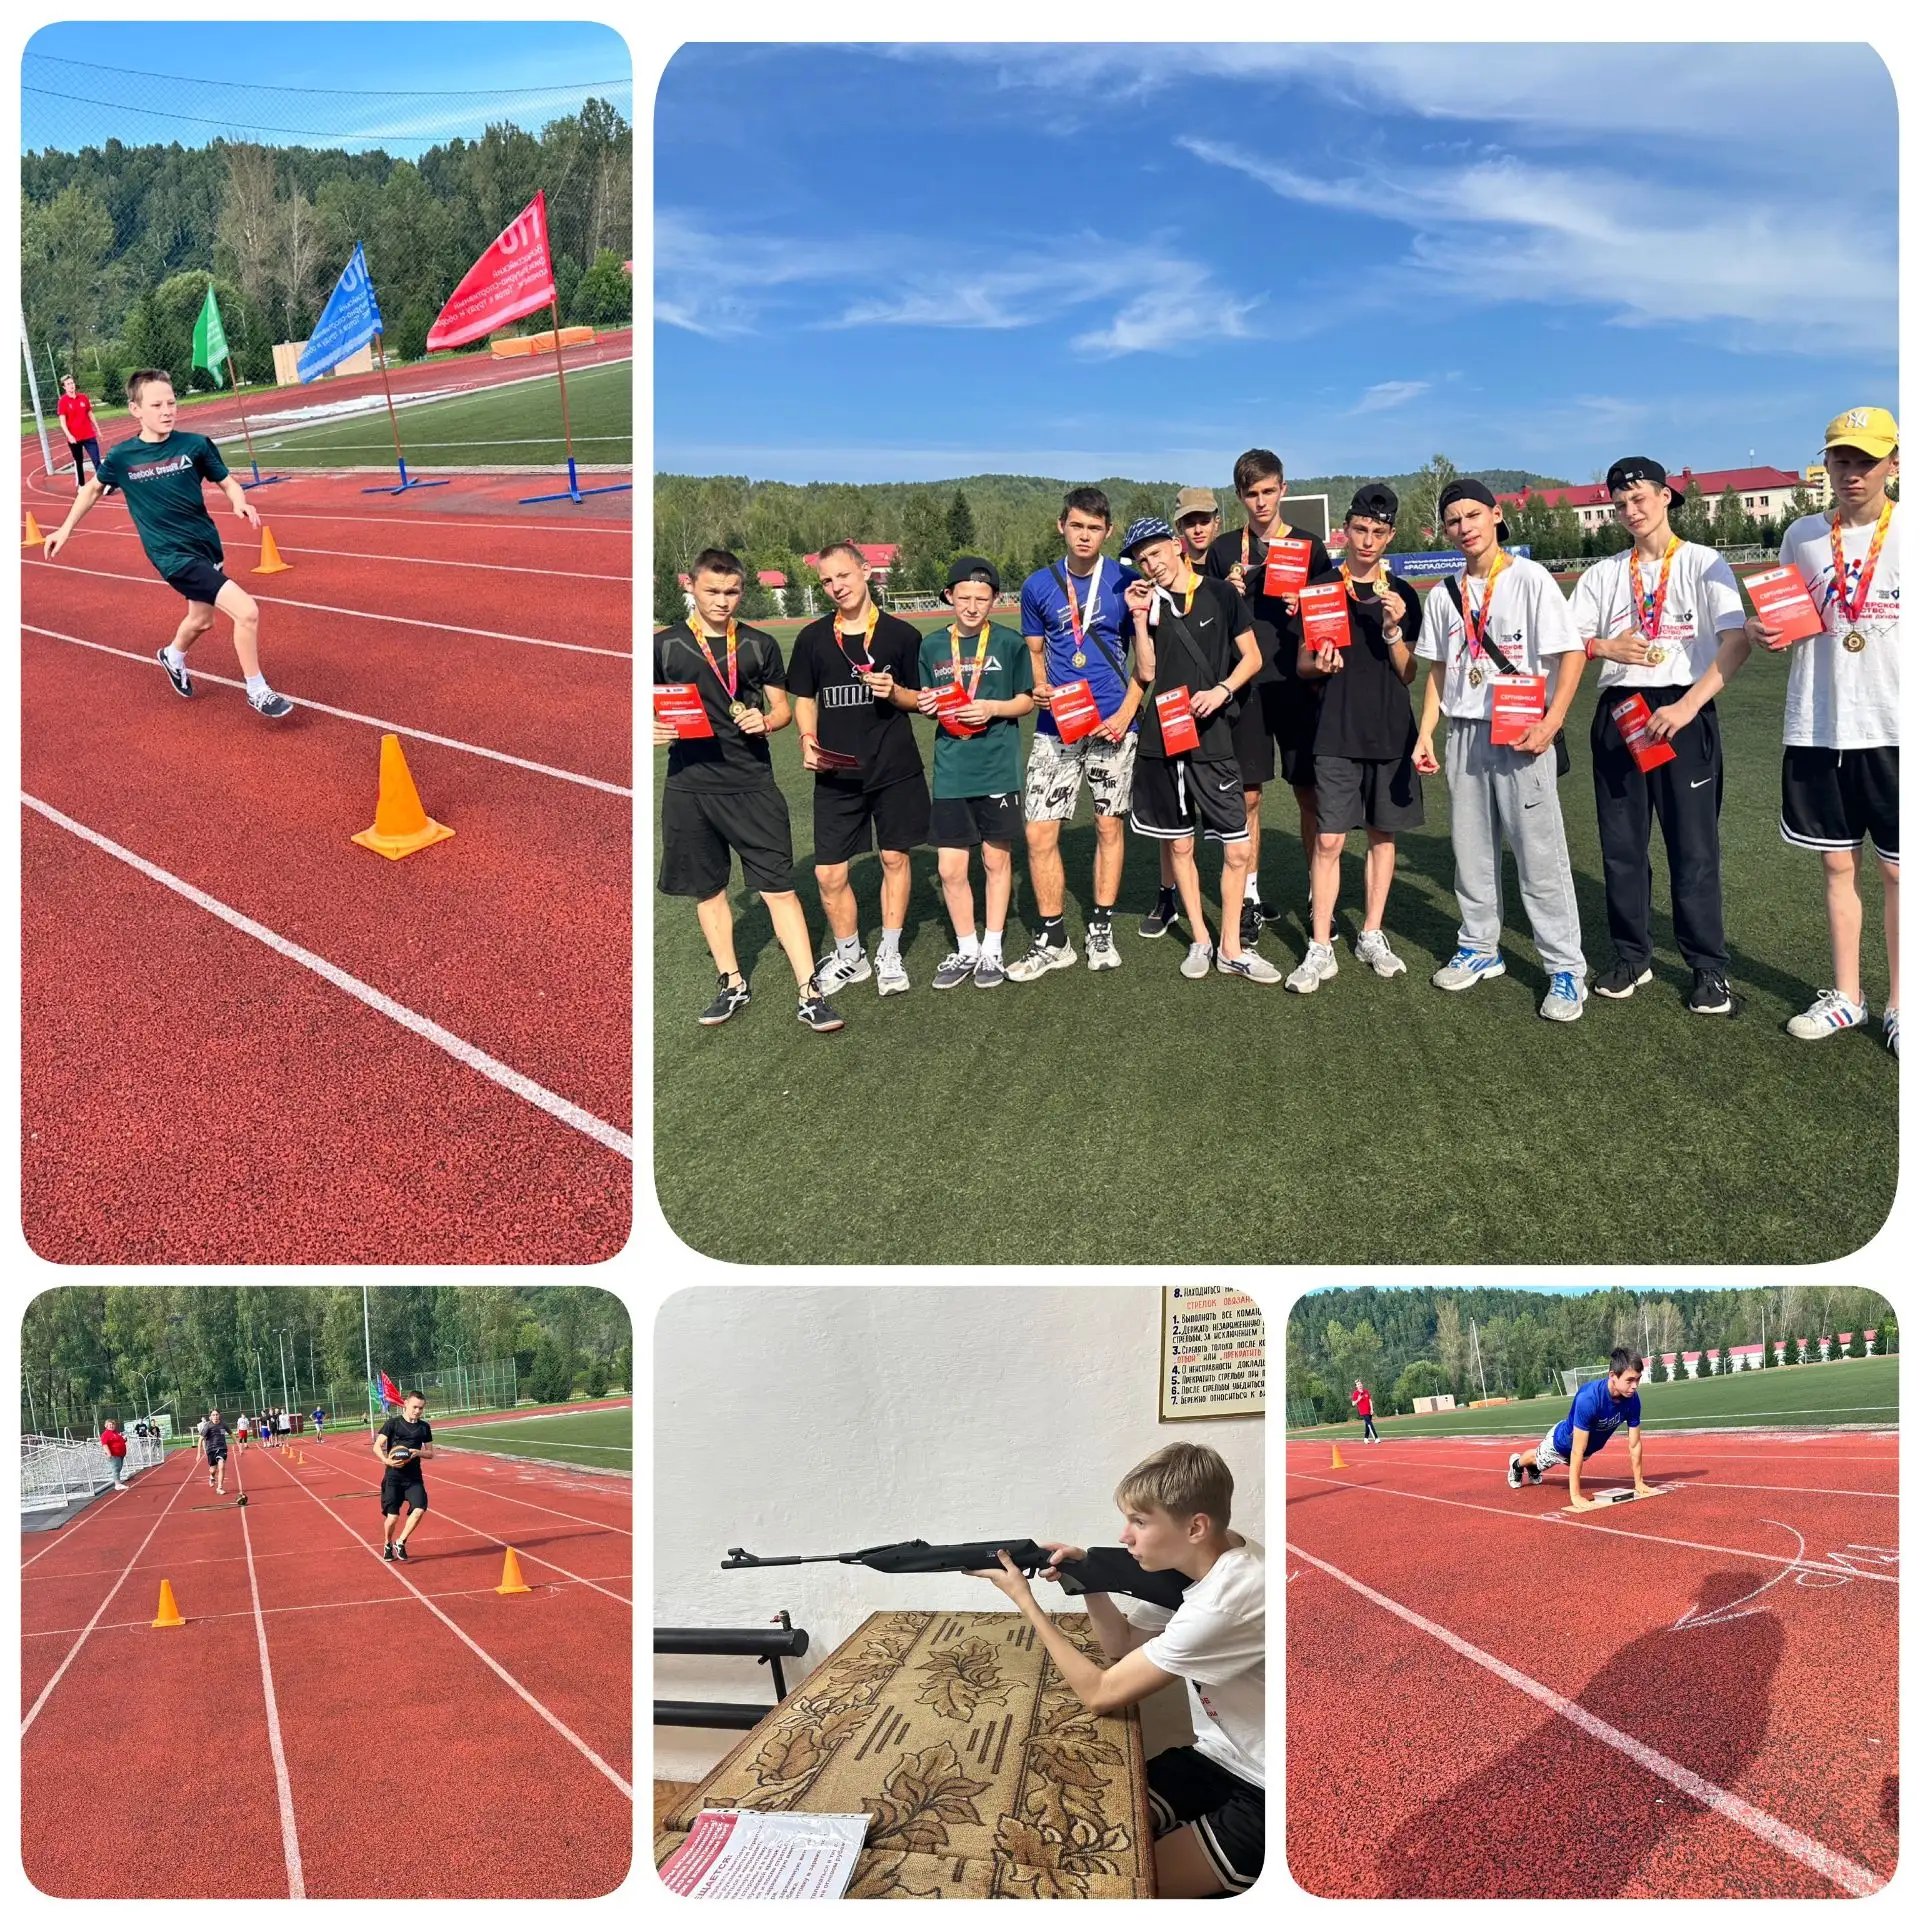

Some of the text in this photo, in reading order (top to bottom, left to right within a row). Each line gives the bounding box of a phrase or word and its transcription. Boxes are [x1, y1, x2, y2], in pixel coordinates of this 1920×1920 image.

[128, 468, 155, 480] Reebok
[1102, 780, 1116, 788] AIR
[1174, 1288, 1182, 1298] 8.
[1187, 1296, 1252, 1310] СТРЕЛОК ОБЯЗАН
[1173, 1315, 1179, 1324] 1.
[1182, 1313, 1216, 1323] ВЫПОЛНЯТЬ
[1222, 1311, 1232, 1319] ВСЕ
[1173, 1319, 1260, 1335] 2. ДЕРЖАТЬ НЕЗАРЯЖЕННУЮ
[1204, 1333, 1210, 1342] ЗА
[1214, 1329, 1258, 1340] ИСКЛЮЧЕНИЕМ
[1172, 1346, 1180, 1355] 3.
[1182, 1346, 1207, 1354] СТРЕЛЯТЬ
[1212, 1343, 1232, 1352] ТОЛЬКО
[1237, 1340, 1255, 1349] ПОСЛЕ
[1172, 1366, 1180, 1374] 4.
[1182, 1365, 1186, 1374] О
[1188, 1362, 1232, 1373] НЕИСПРАВНОСТИ
[1172, 1376, 1180, 1385] 5.
[1182, 1375, 1215, 1384] ПРЕКРАТИТЬ
[1218, 1372, 1244, 1381] СТРЕЛЬБУ
[1172, 1380, 1265, 1395] 6. ПОСЛЕ СТРЕЛЬБЫ УБЕДИТЬСЯ
[1171, 1397, 1178, 1405] 7.
[1181, 1396, 1206, 1405] БЕРЕЖНО
[1210, 1392, 1248, 1402] ОТНОСИТЬСЯ
[673, 1822, 709, 1868] БЕЗОПАСНОСТИ
[793, 1877, 809, 1898] нтовку
